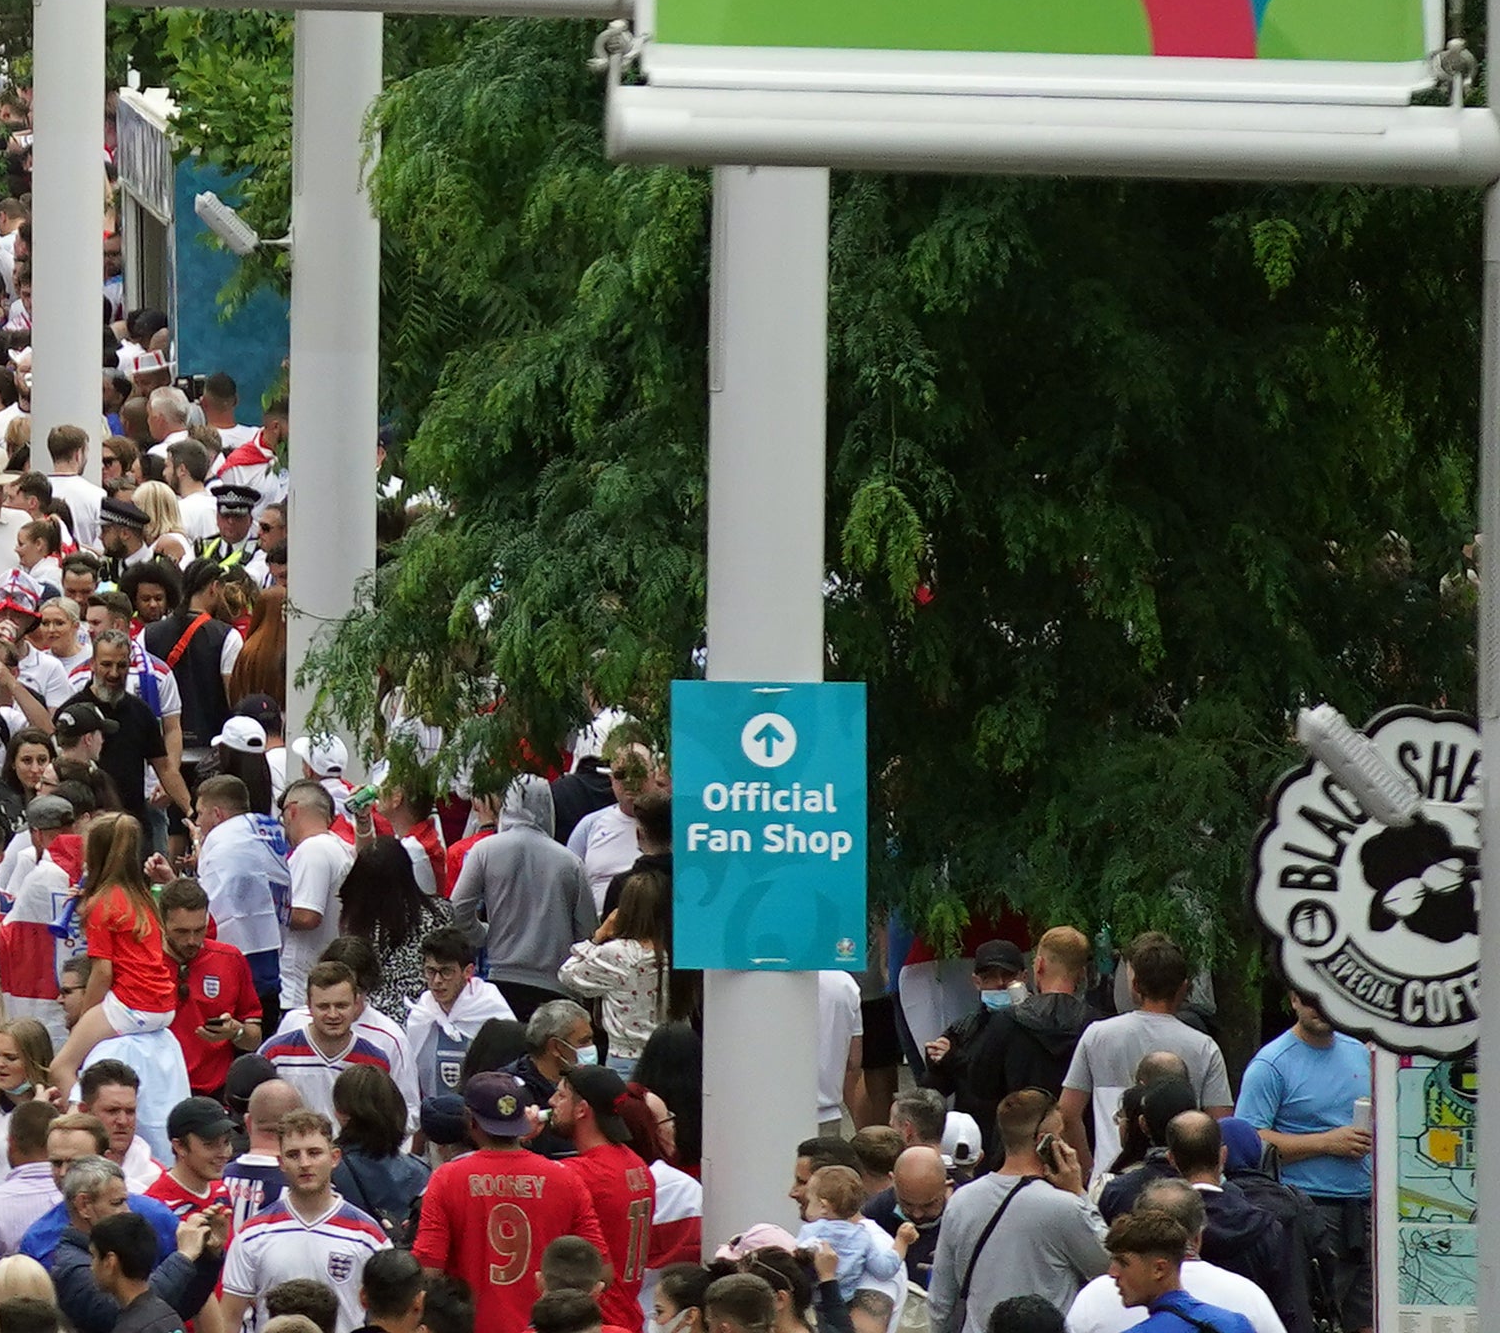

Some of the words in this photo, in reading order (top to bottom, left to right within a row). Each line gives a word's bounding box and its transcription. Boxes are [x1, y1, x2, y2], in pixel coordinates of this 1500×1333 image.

[703, 782, 837, 814] Official
[687, 824, 753, 855] Fan
[762, 824, 854, 861] Shop
[1280, 768, 1366, 892] BLAC
[1326, 952, 1398, 1010] SPECIAL
[468, 1174, 547, 1199] ROONEY
[487, 1202, 532, 1286] 9
[624, 1196, 652, 1283] 11
